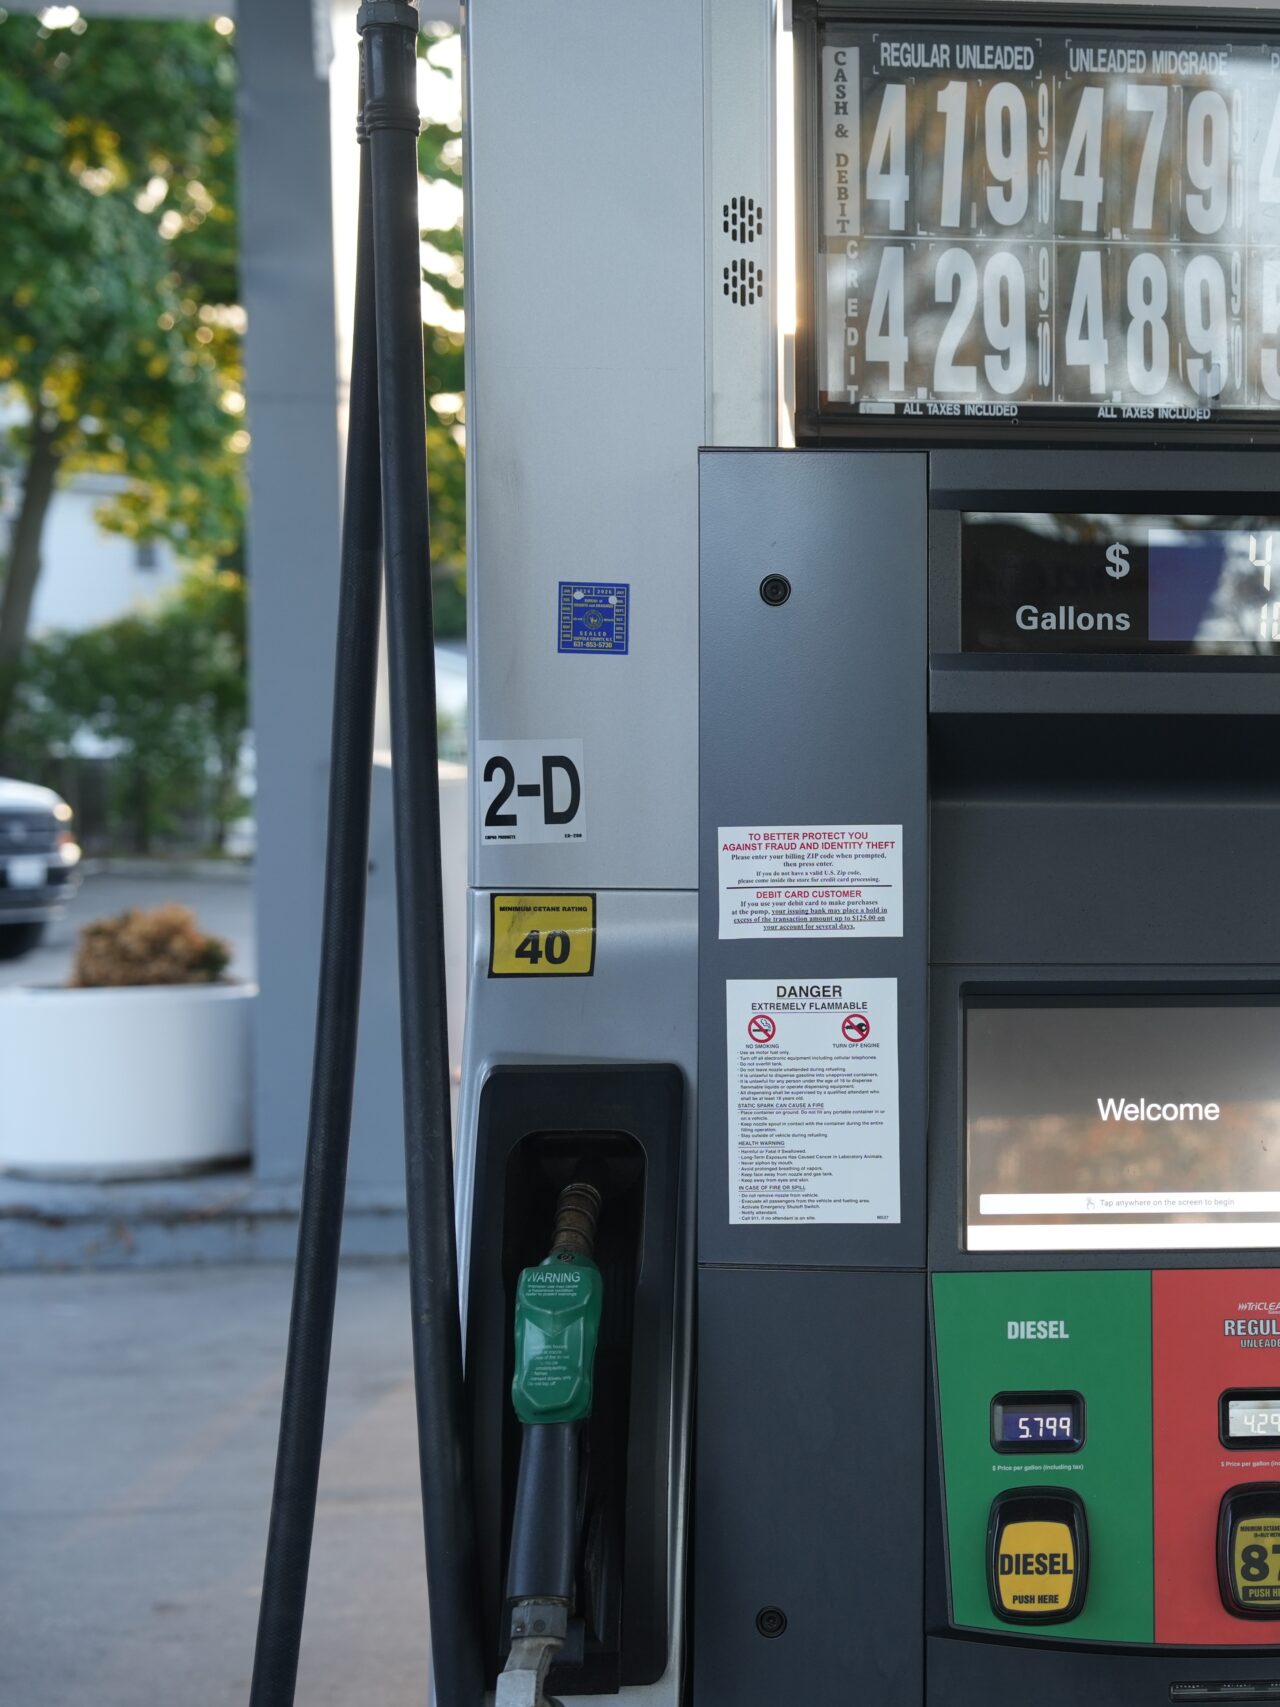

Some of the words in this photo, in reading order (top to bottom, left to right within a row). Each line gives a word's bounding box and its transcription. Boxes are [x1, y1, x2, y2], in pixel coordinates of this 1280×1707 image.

[880, 42, 950, 68] REGULAR
[956, 45, 1034, 71] UNLEADED
[1070, 48, 1147, 74] UNLEADED
[1152, 51, 1228, 76] MIDGRADE
[834, 51, 849, 116] CASH
[835, 124, 849, 138] &
[835, 153, 850, 234] DEBIT
[846, 240, 859, 405] CREDIT
[904, 403, 922, 415] ALL
[926, 403, 961, 415] TAXES
[964, 404, 1018, 416] INCLUDED
[1097, 407, 1117, 419] ALL
[1120, 407, 1155, 419] TAXES
[1158, 408, 1211, 420] INCLUDED
[1105, 541, 1130, 580] $
[1015, 604, 1131, 632] Gallons
[483, 755, 581, 827] 2-D
[748, 833, 761, 841] TO
[763, 833, 800, 841] BETTER
[802, 832, 846, 840] PROTECT
[848, 832, 868, 840] YOU
[722, 843, 763, 851] AGAINST
[765, 843, 797, 851] FRAUD
[800, 842, 819, 850] AND
[821, 842, 863, 850] IDENTITY
[866, 841, 896, 849] THEFT
[812, 890, 862, 898] CUSTOMER
[847, 899, 878, 907] purchases
[515, 929, 571, 965] 40
[776, 985, 843, 998] DANGER
[751, 1002, 806, 1011] EXTREMELY
[809, 1001, 868, 1010] FLAMMABLE
[1097, 1097, 1220, 1122] Welcome
[1100, 1199, 1114, 1208] Tap
[1115, 1199, 1151, 1207] anywhere
[1164, 1198, 1176, 1206] the
[1204, 1198, 1212, 1206] to
[1214, 1198, 1235, 1207] begin
[527, 1272, 581, 1283] WARNING
[1007, 1321, 1069, 1339] DIESEL
[1018, 1417, 1071, 1439] 5.799
[997, 1464, 1011, 1472] Price
[1013, 1464, 1023, 1472] per
[1024, 1464, 1042, 1472] gallon
[1043, 1464, 1072, 1472] (including
[1072, 1464, 1084, 1472] tax)
[1000, 1553, 1073, 1576] DIESEL
[1249, 1587, 1270, 1597] PUSH
[1012, 1595, 1036, 1605] PUSH
[1037, 1594, 1059, 1604] HERE
